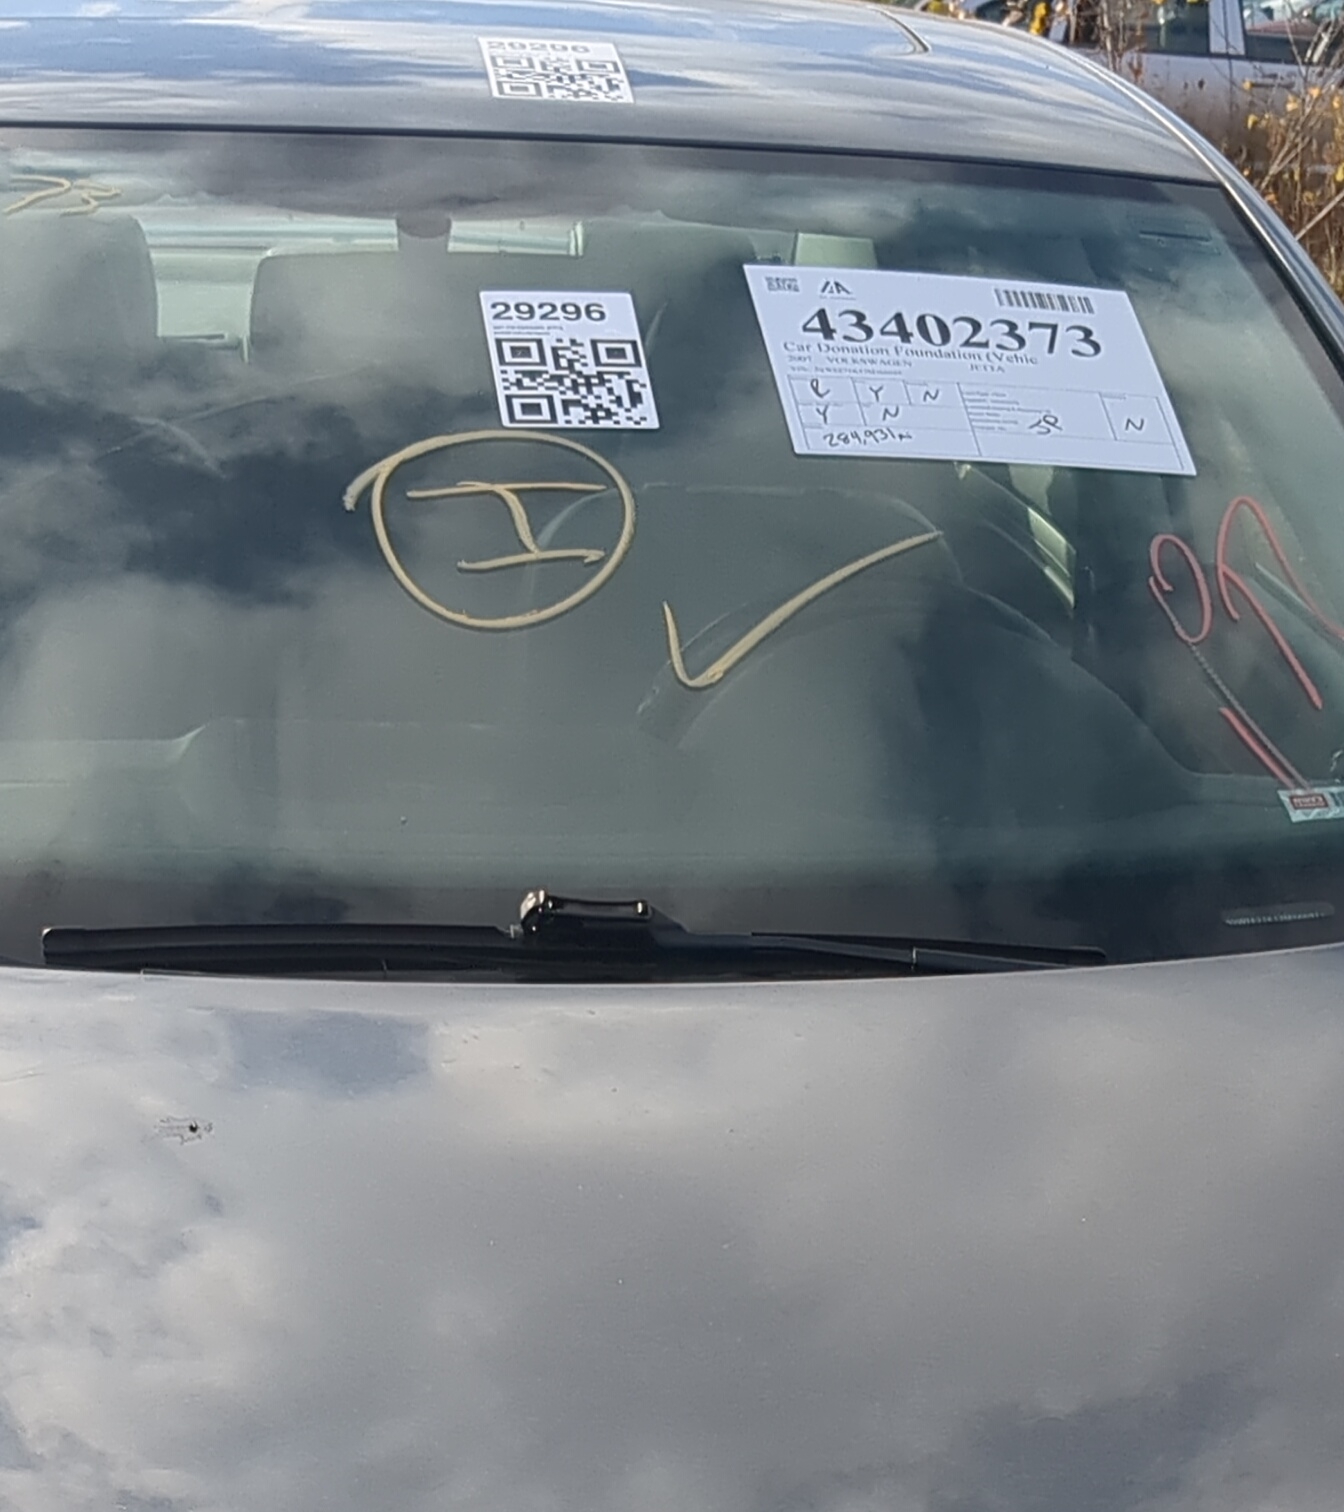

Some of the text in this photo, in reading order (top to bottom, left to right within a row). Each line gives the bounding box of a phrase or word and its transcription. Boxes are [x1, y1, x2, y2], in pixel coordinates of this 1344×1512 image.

[487, 41, 590, 53] 29296
[490, 301, 607, 322] 29296
[801, 307, 1103, 359] 43402373
[783, 340, 812, 354] Car
[817, 341, 892, 357] Donation
[894, 345, 982, 363] Foundation
[869, 385, 884, 402] Y
[922, 388, 940, 403] N
[816, 404, 900, 425] Y N
[1124, 417, 1145, 432] N
